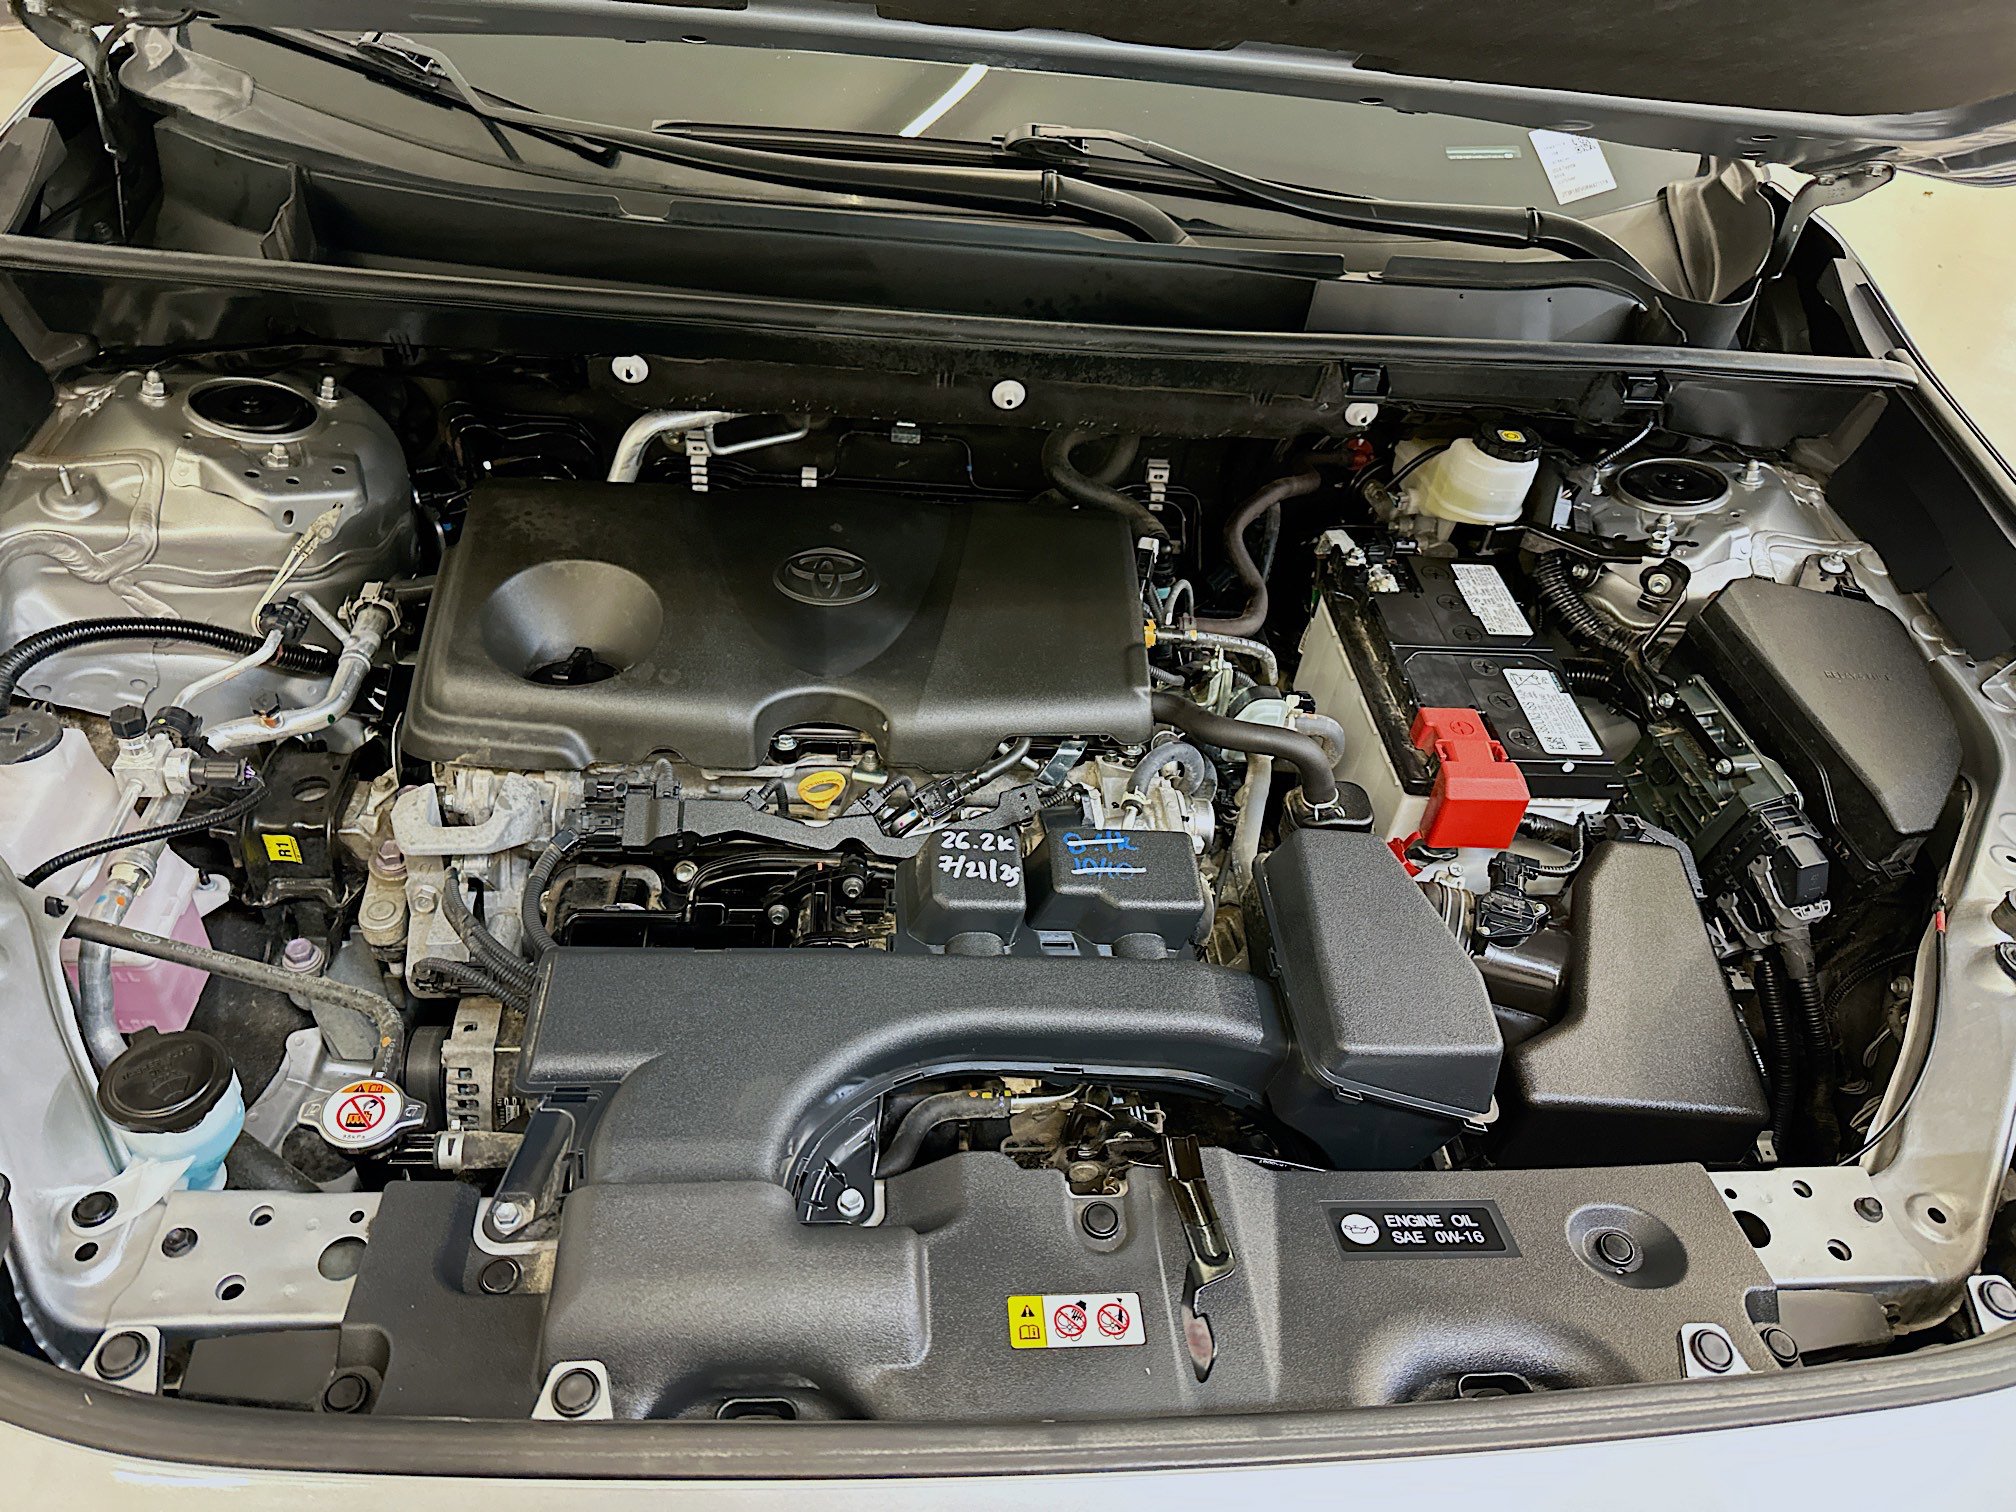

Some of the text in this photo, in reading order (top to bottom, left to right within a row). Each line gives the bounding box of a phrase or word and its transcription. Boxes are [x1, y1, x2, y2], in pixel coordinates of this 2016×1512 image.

[938, 855, 1021, 887] 7/21/25
[1384, 1214, 1479, 1228] ENGINE OIL
[1391, 1231, 1485, 1244] SAE 0W-16
